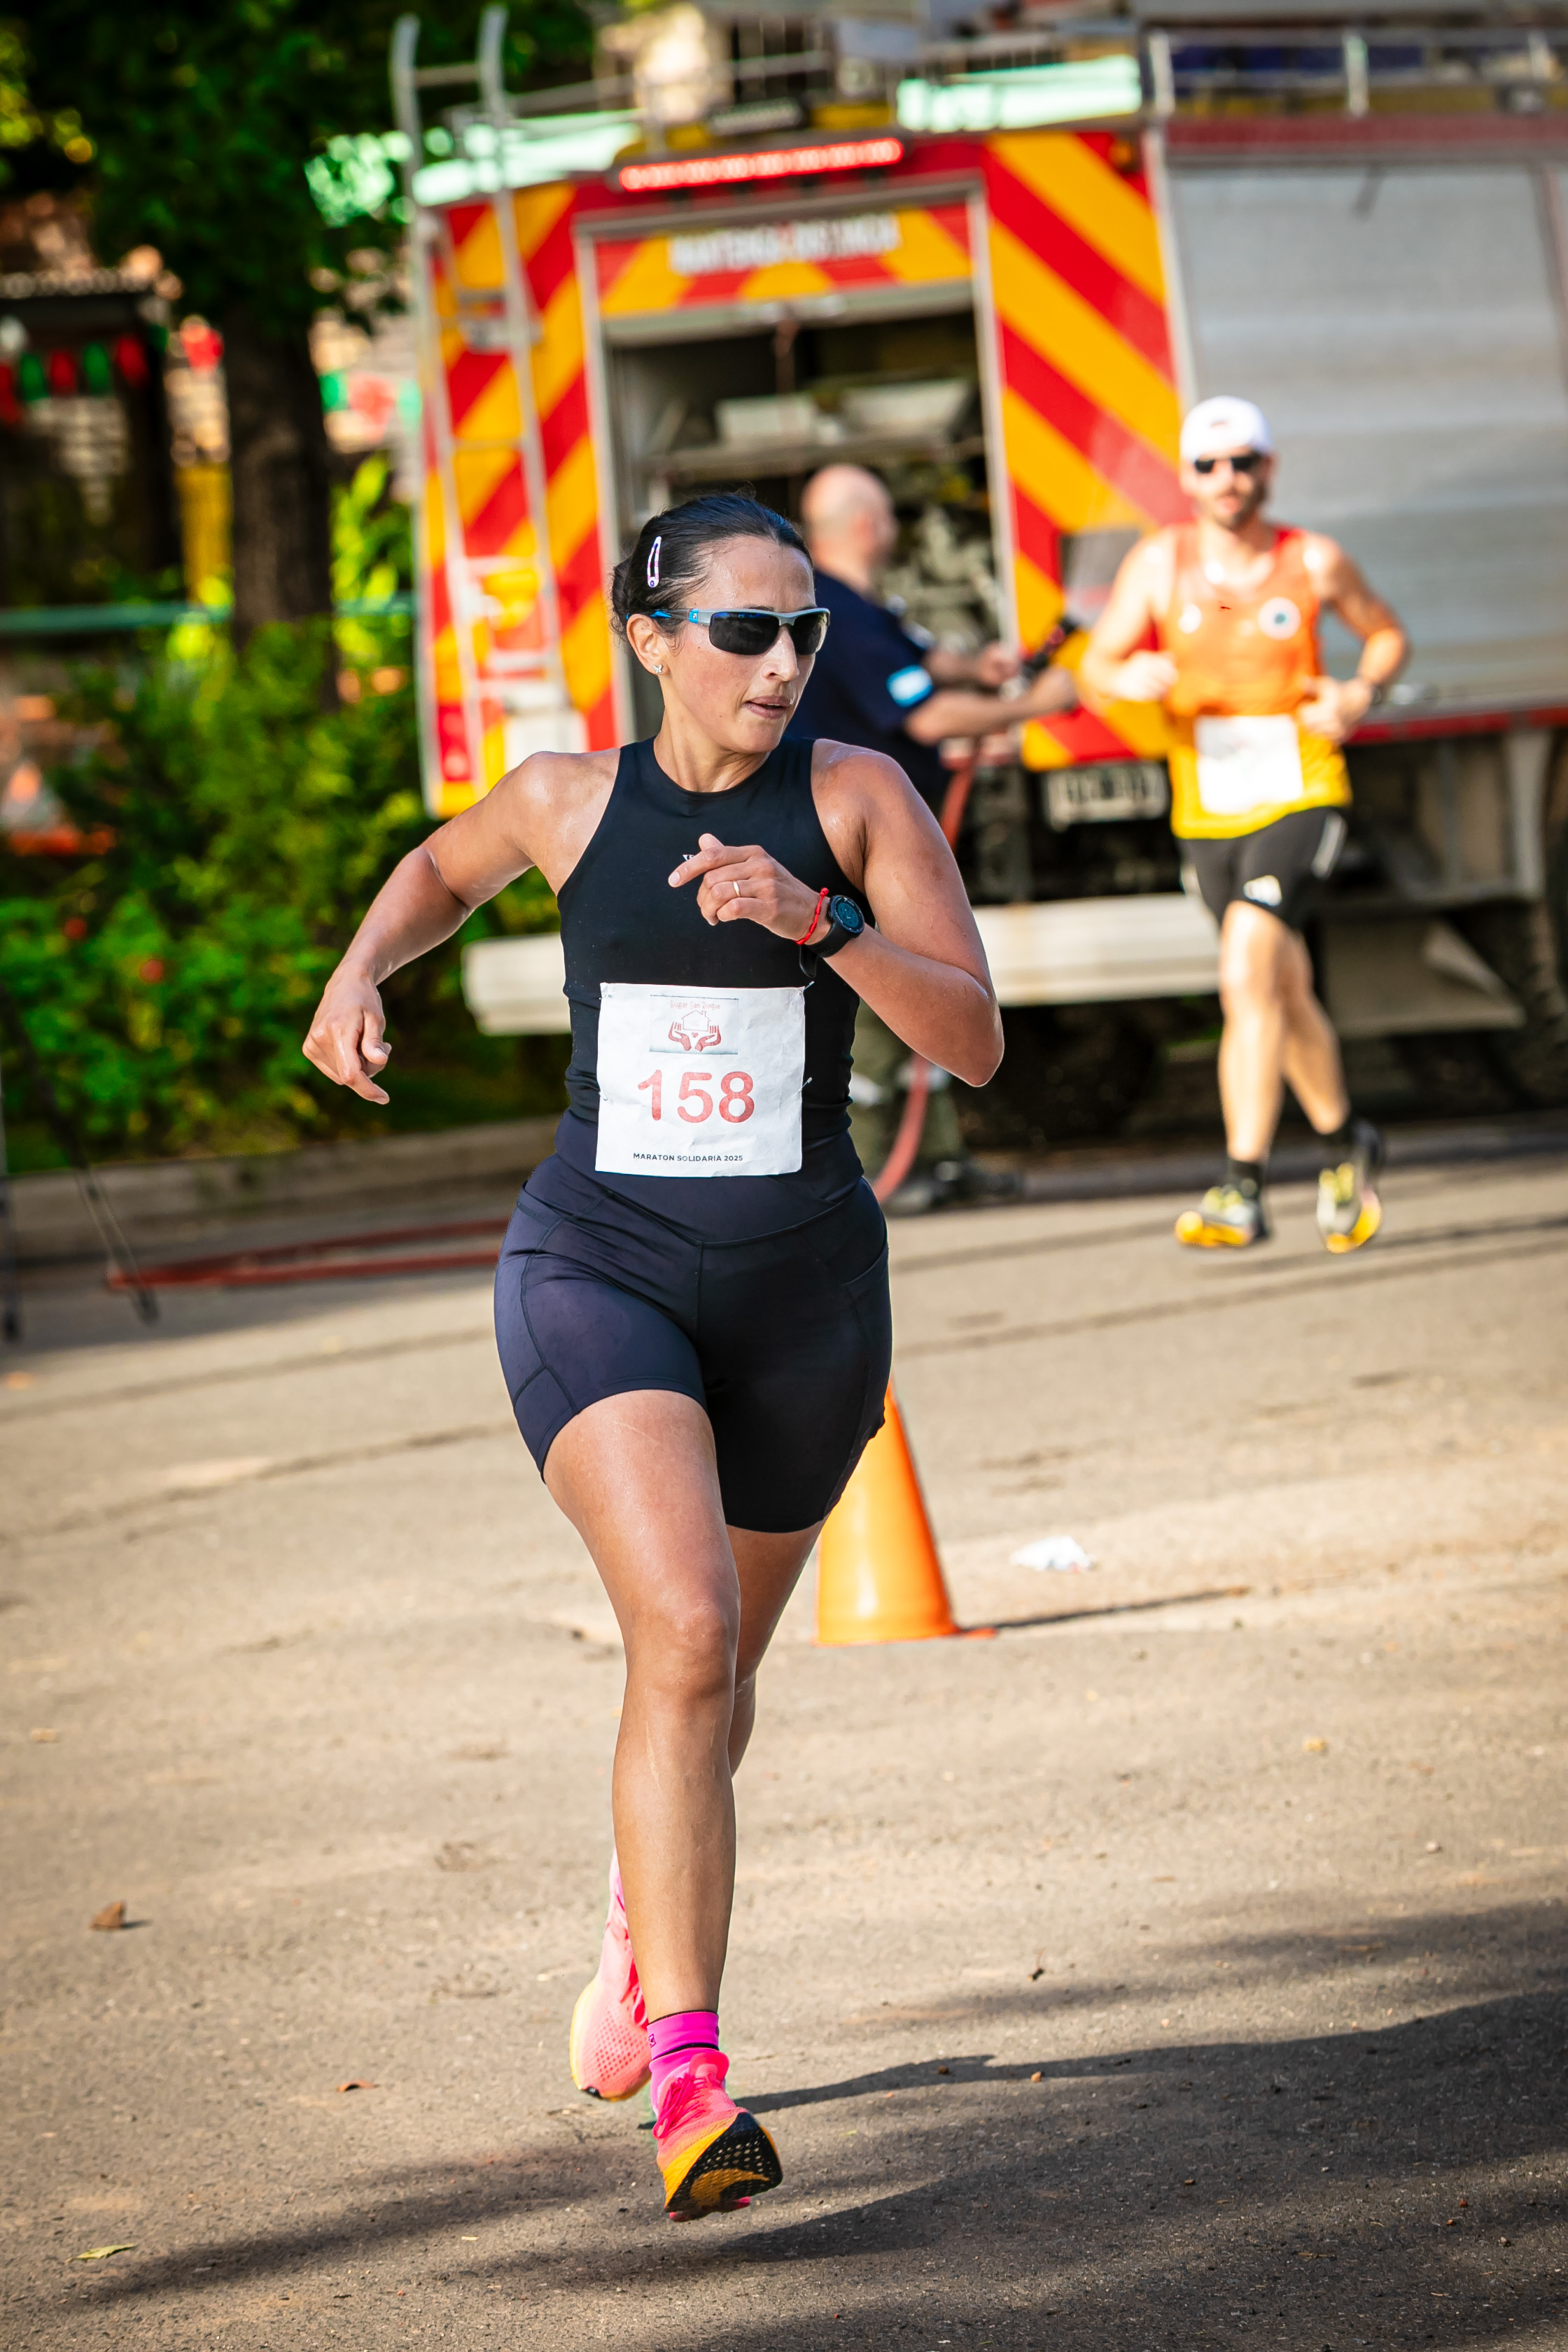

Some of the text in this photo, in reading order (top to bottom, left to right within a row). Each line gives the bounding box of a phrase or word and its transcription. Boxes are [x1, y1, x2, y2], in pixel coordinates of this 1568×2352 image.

[670, 1000, 721, 1011] Hogar San Roque
[638, 1070, 755, 1124] 158
[633, 1153, 675, 1161] MARATON
